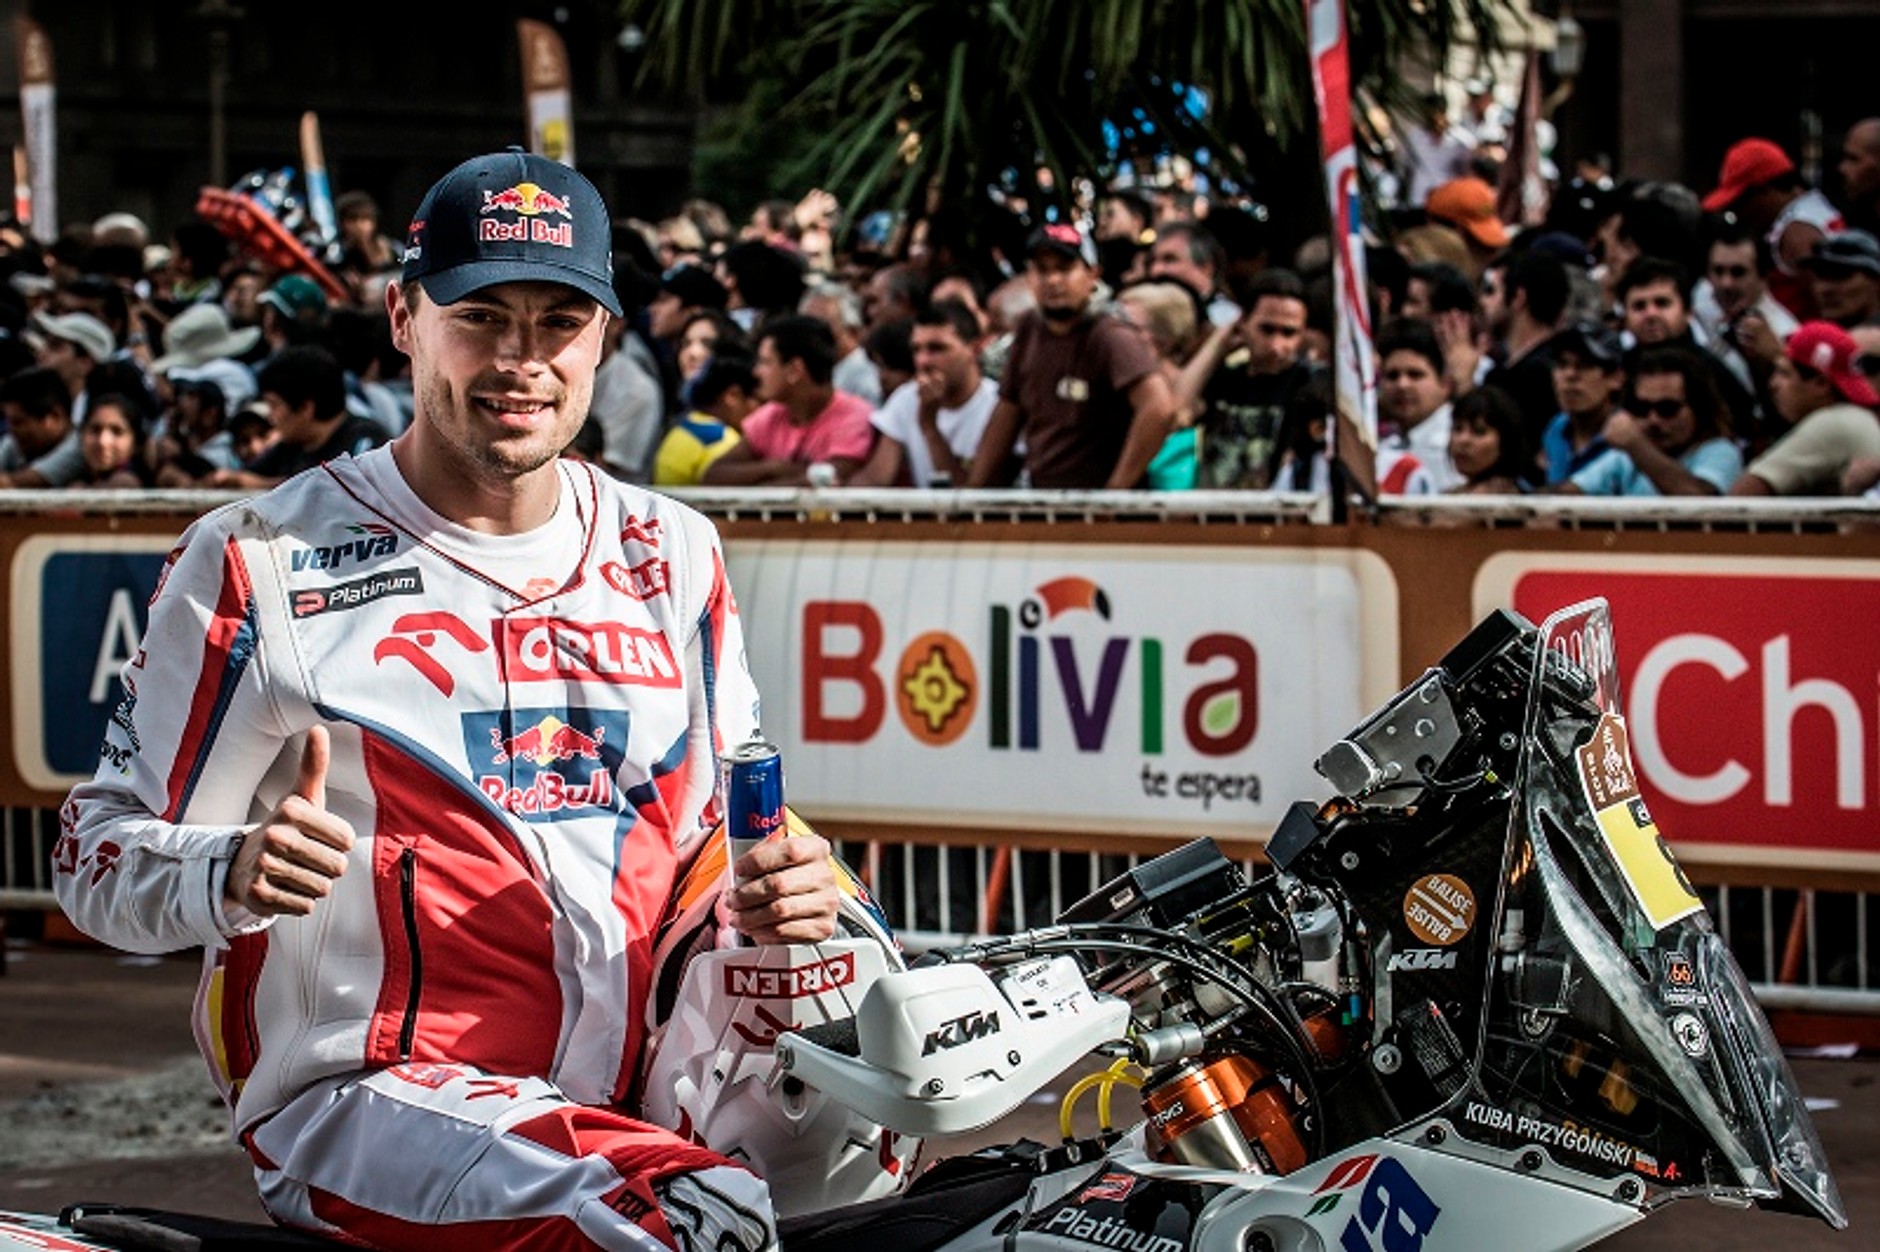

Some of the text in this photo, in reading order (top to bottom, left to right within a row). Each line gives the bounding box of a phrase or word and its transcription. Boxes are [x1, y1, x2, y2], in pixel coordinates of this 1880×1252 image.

[480, 216, 573, 248] Red Bull
[291, 535, 399, 572] verva
[328, 577, 416, 606] Platinum
[519, 624, 676, 679] ORLEN
[801, 598, 1260, 758] Bolivia
[479, 767, 613, 814] Red Bull
[1141, 764, 1262, 811] te espera
[1426, 876, 1473, 914] BALISE
[1407, 901, 1452, 941] BALISE
[732, 960, 848, 995] ORLEN
[1386, 949, 1458, 971] KTM
[921, 1009, 1001, 1058] KTM
[1464, 1101, 1514, 1134] KUBA
[1045, 1206, 1183, 1252] Platinum
